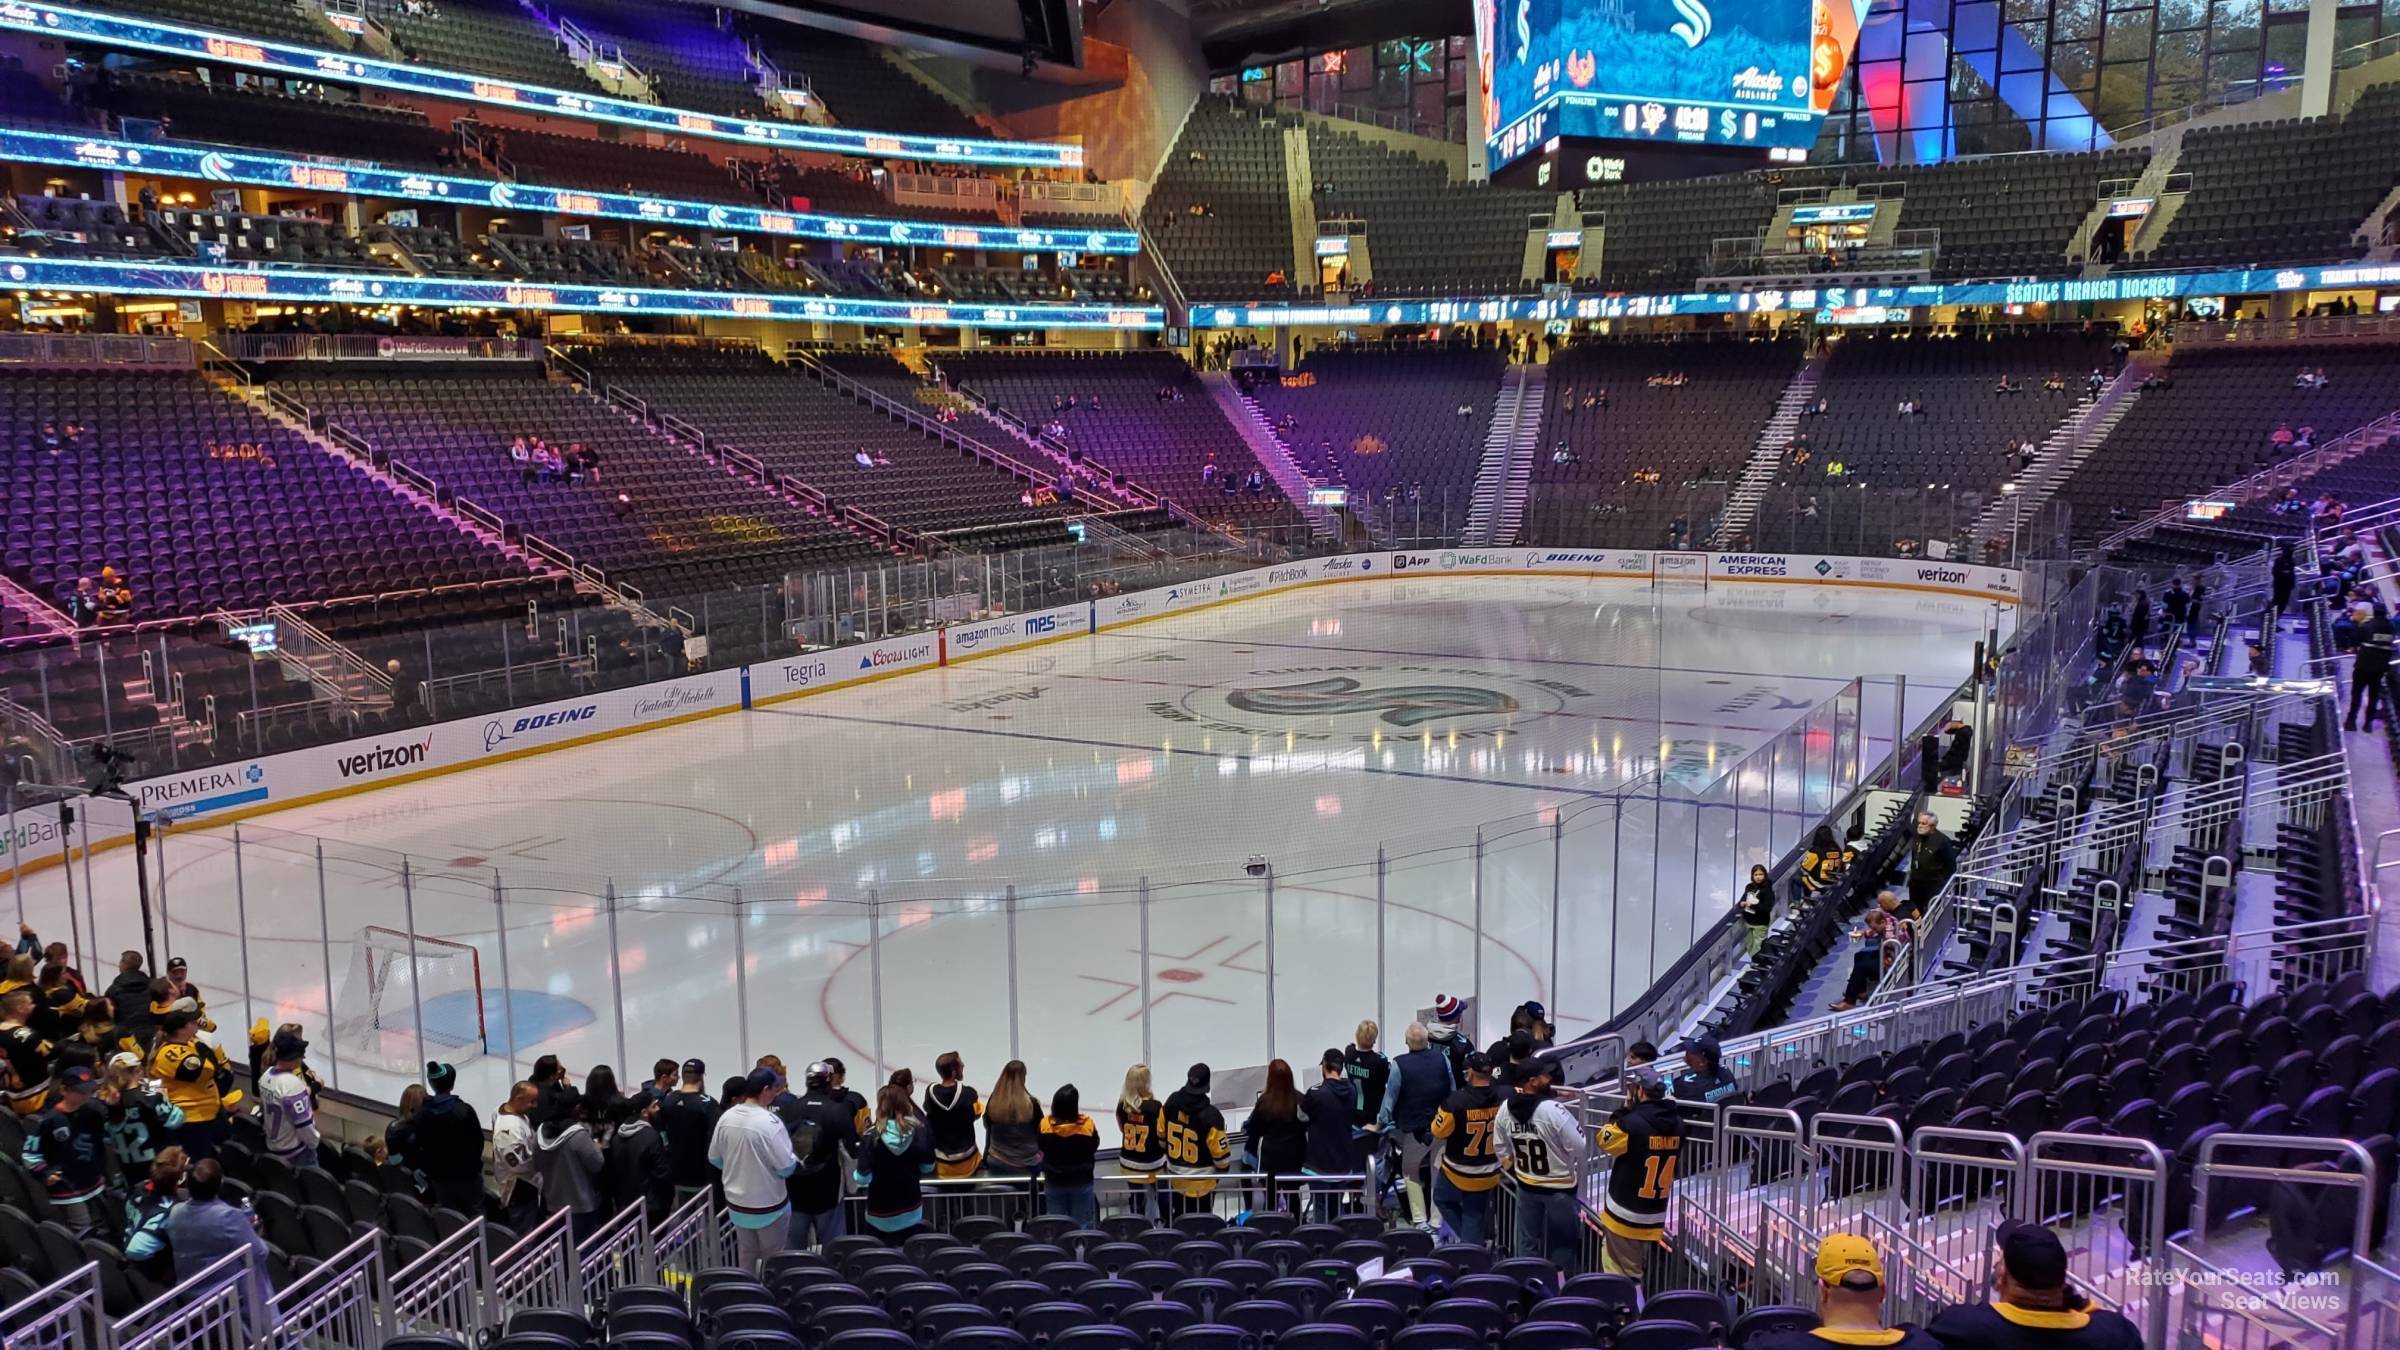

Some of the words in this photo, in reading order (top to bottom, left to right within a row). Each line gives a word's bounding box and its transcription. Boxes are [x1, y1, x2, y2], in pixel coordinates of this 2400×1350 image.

[1732, 66, 1783, 91] Alaska
[1735, 89, 1778, 101] AIRLINES
[2006, 283, 2059, 303] SEATTLE
[2064, 281, 2116, 301] KRAKEN
[2122, 277, 2176, 298] HOCKEY
[1322, 558, 1353, 572] Alaska
[1546, 554, 1605, 563] BOEING
[1719, 555, 1786, 566] AMERICAN
[1274, 565, 1309, 582] PitchBook
[1728, 565, 1787, 576] EXPRESS
[1917, 567, 1965, 584] verizon
[1180, 583, 1211, 598] SYMETRA
[956, 629, 989, 645] amazon
[989, 622, 1016, 639] music
[1025, 615, 1055, 636] MPS
[872, 649, 903, 667] Coors
[903, 645, 930, 660] LIGHT
[784, 661, 826, 685] Tegria
[512, 705, 598, 733] BOEING
[338, 743, 424, 778] verizon
[140, 772, 236, 807] PREMERA
[1167, 1121, 1199, 1164] 56
[1511, 1138, 1550, 1175] 58
[1637, 1154, 1677, 1200] 14
